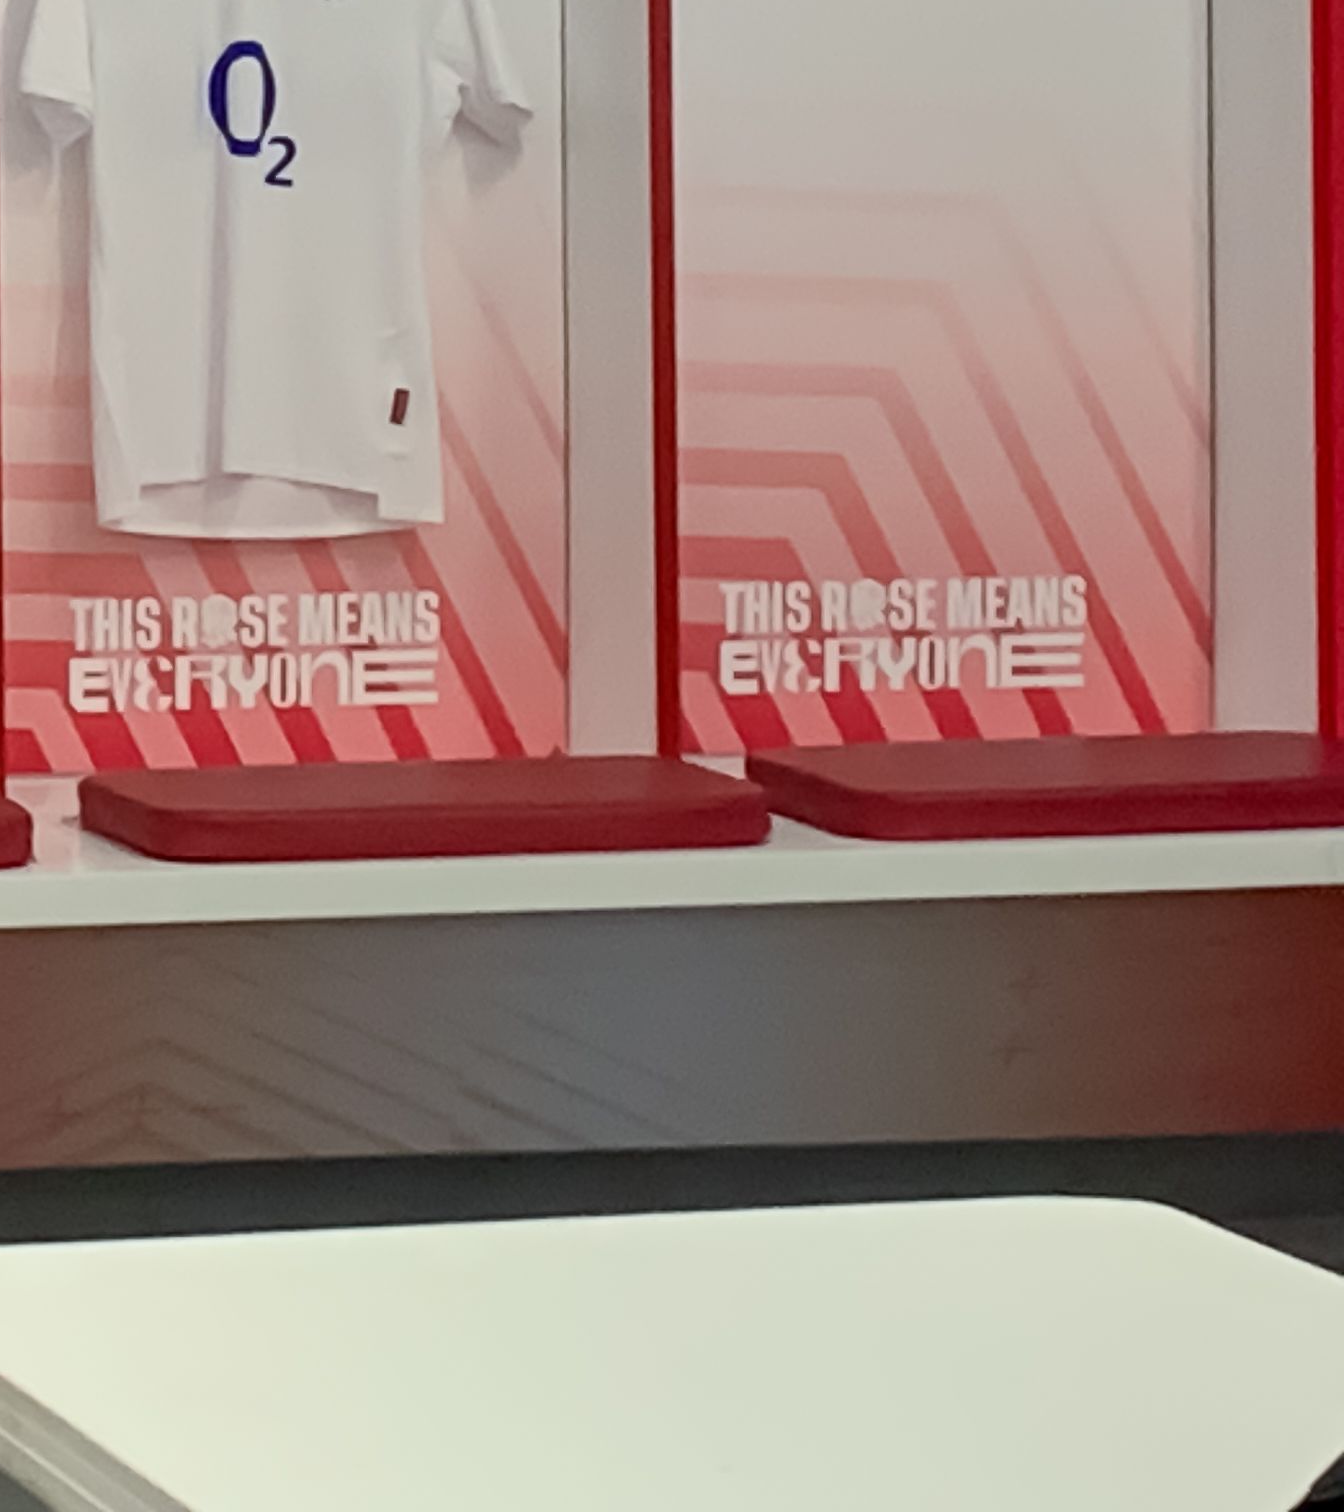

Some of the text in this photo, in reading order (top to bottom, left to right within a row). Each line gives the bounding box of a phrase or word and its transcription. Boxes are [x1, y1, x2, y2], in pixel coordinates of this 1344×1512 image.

[208, 41, 297, 187] O2
[69, 596, 161, 651] THIS
[298, 590, 440, 646] MEANS
[720, 580, 812, 634] THIS
[946, 574, 1086, 630] MEANS
